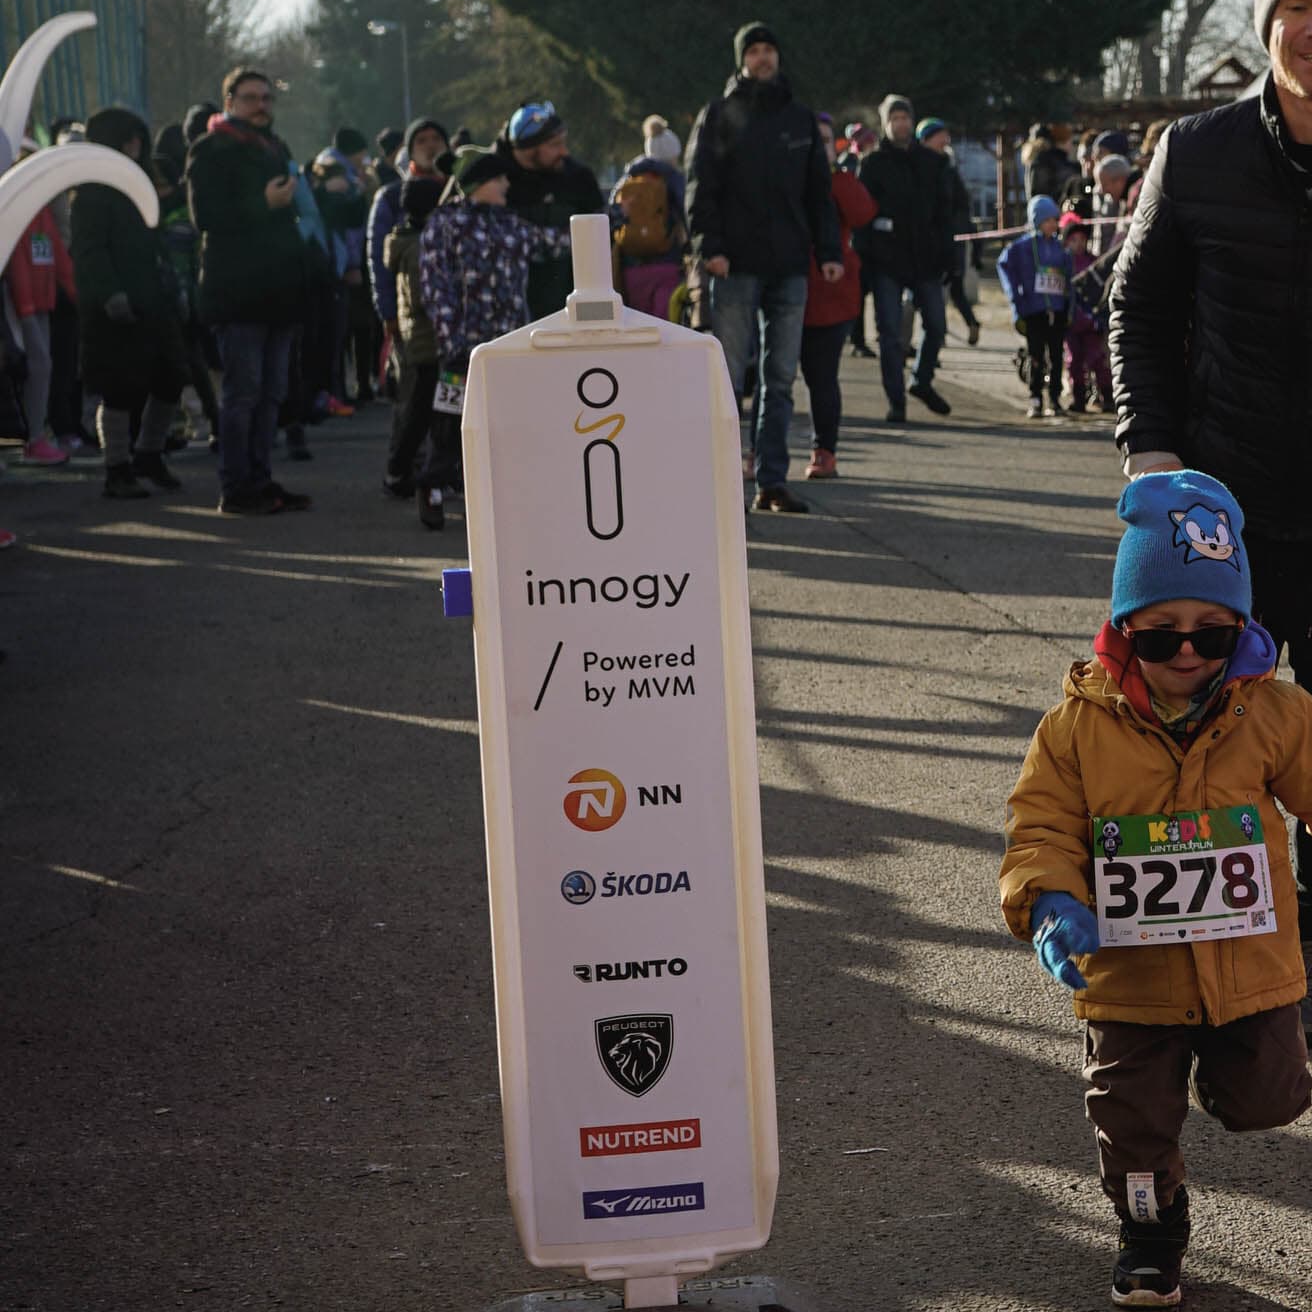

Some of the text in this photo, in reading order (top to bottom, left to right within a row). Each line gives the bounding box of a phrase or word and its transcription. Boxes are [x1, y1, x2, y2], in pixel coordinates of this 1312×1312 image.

[526, 570, 691, 609] innogy
[583, 645, 696, 673] Powered
[584, 676, 696, 707] by MVM
[637, 784, 682, 807] NN
[601, 871, 692, 898] ŠKODA
[1103, 852, 1259, 919] 3278
[595, 958, 688, 982] RUNTO
[602, 1021, 664, 1032] PEUGEOT
[587, 1126, 696, 1150] NUTREND
